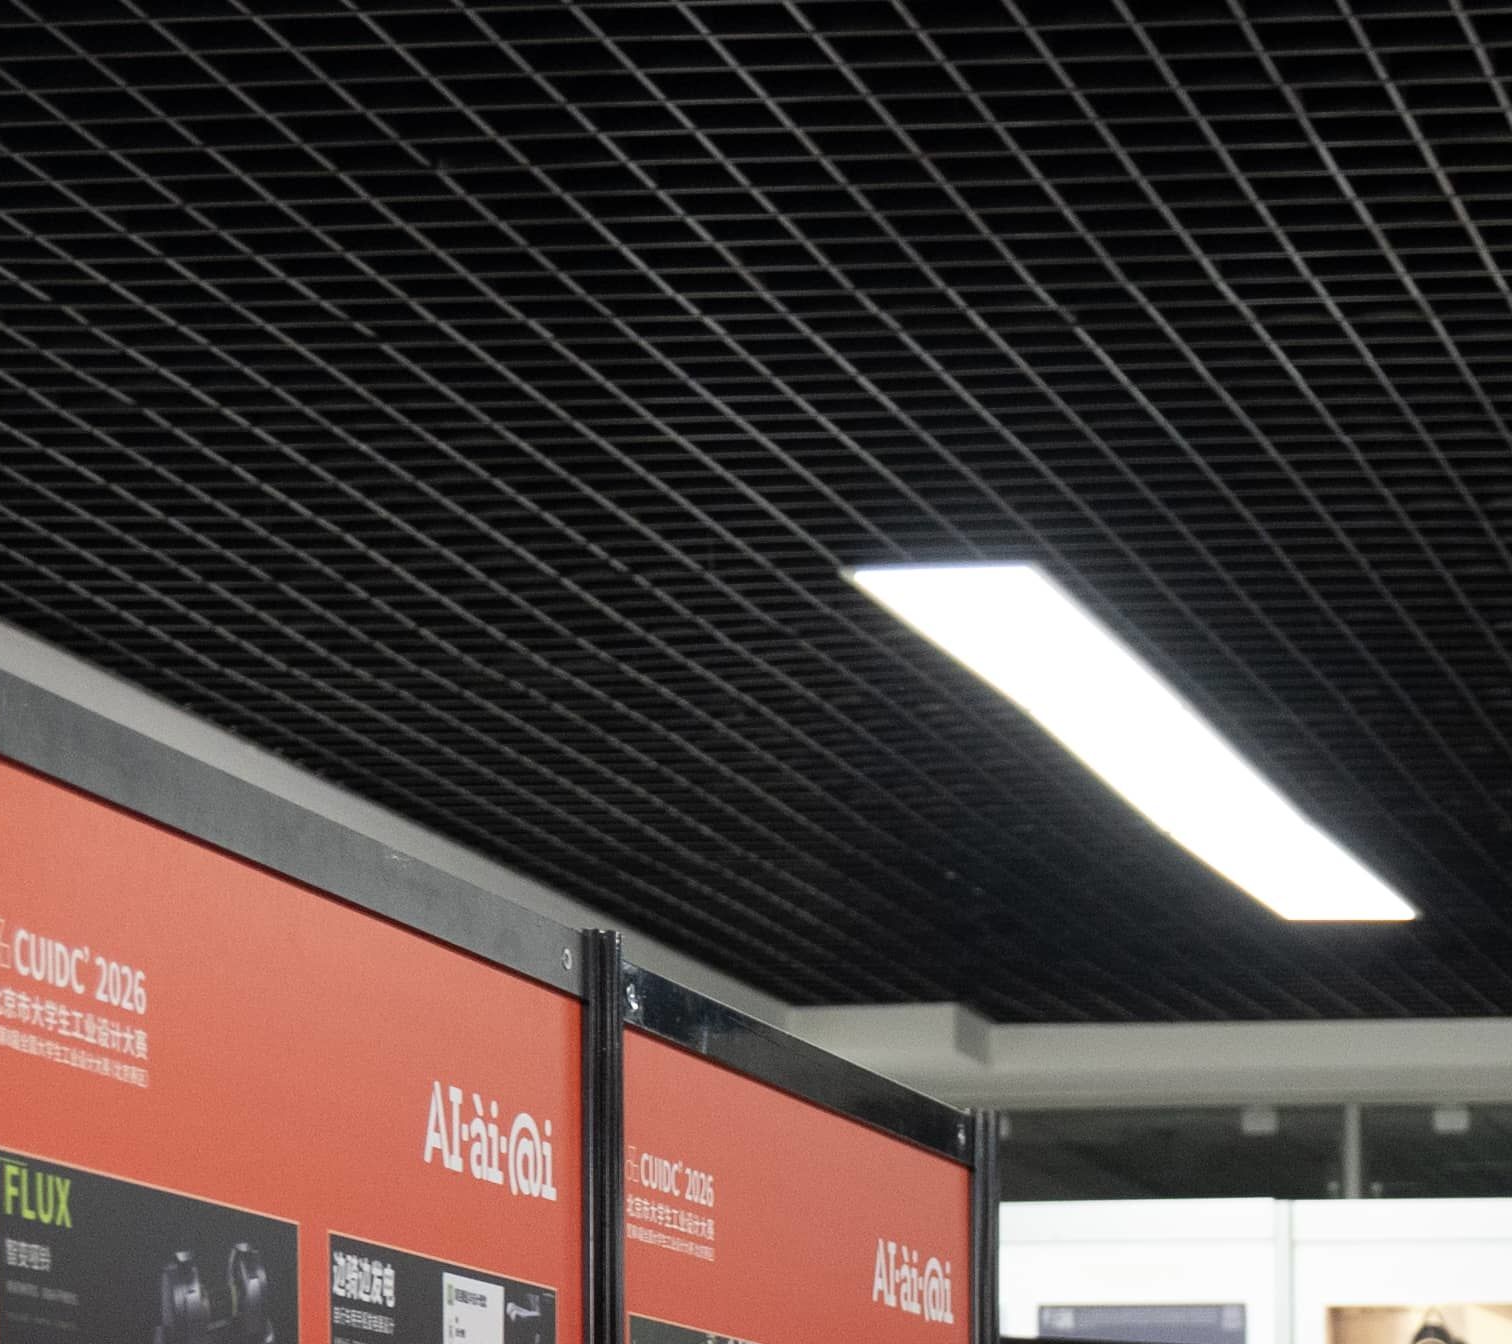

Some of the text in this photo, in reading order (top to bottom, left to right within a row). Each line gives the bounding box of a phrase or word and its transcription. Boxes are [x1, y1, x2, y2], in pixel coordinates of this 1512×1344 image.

[95, 956, 147, 1016] 2026
[4, 1163, 72, 1228] FLUX
[685, 1168, 715, 1208] 2026
